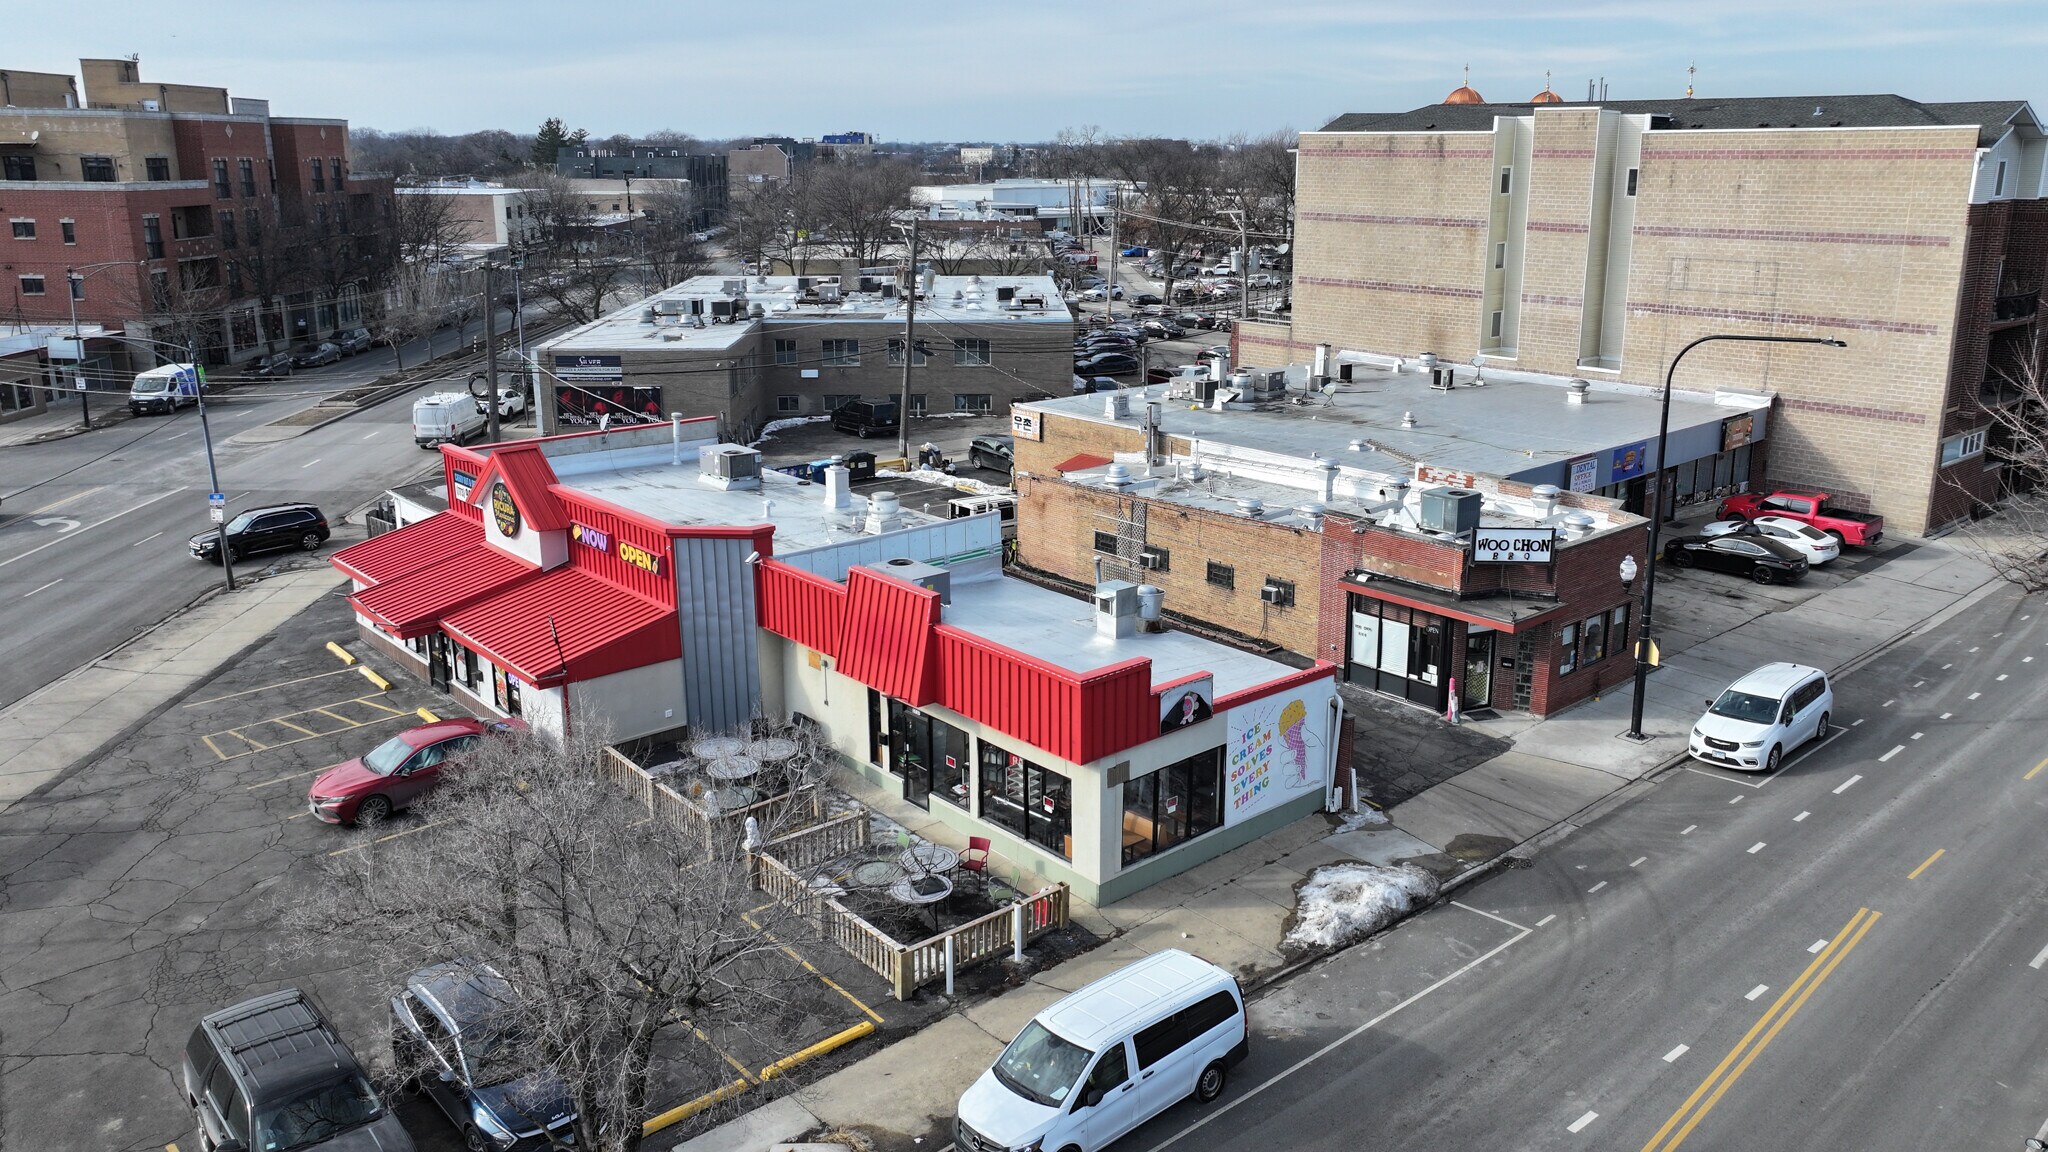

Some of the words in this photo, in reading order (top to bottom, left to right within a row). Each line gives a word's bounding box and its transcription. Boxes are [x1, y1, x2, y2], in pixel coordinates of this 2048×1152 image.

[1014, 416, 1032, 432] 우촌
[1574, 471, 1592, 481] OFFICE
[1576, 461, 1596, 473] DENTAL
[581, 526, 607, 552] NOW
[1478, 538, 1510, 551] WOO
[1513, 539, 1551, 552] CHON
[620, 542, 652, 571] OPEN
[1426, 626, 1439, 635] OPEN
[1241, 722, 1261, 744] ICE
[1231, 729, 1271, 766] CREAM
[1230, 744, 1273, 782] SOLVES
[1233, 760, 1270, 796] EVERY
[1234, 776, 1270, 810] THING
